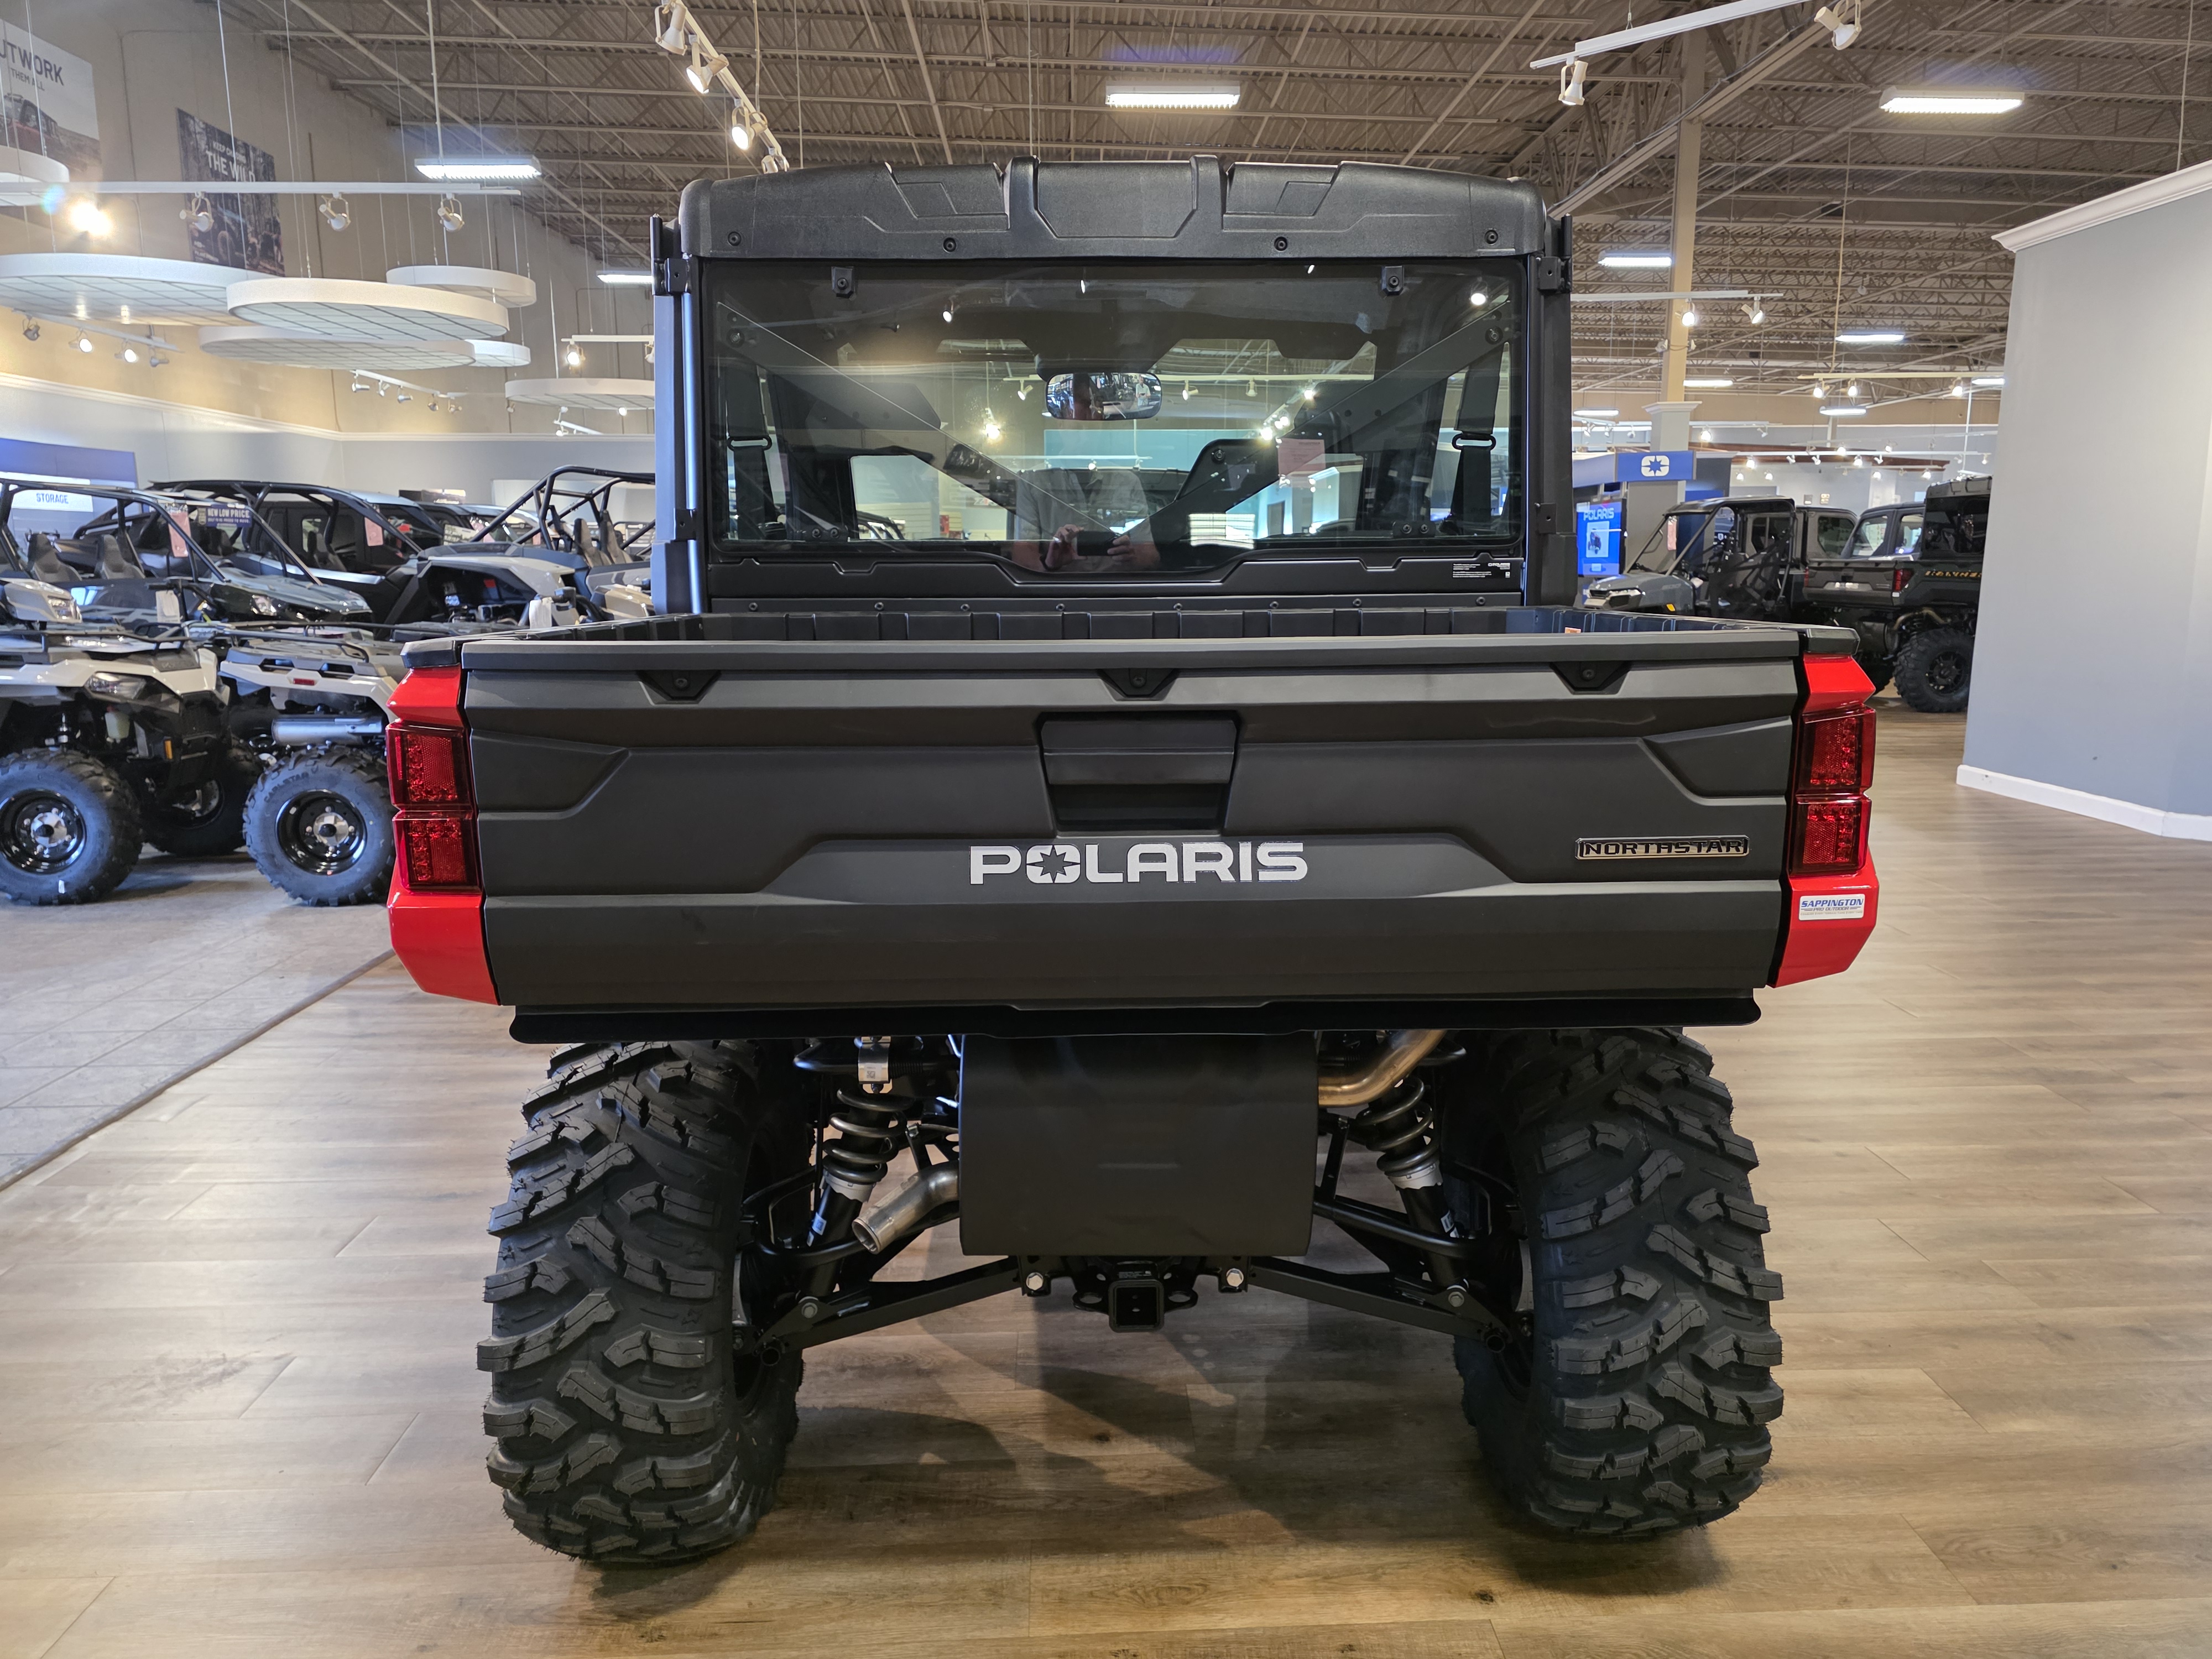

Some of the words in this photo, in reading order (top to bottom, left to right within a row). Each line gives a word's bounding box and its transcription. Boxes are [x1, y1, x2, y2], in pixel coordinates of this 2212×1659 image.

[11, 67, 30, 84] THEM
[206, 150, 228, 175] THE
[36, 493, 69, 504] STORAGE
[219, 509, 229, 517] LOW
[231, 509, 249, 518] PRICE
[1584, 508, 1614, 521] POLARIS
[1585, 839, 1743, 855] NORTHSTAR
[969, 841, 1308, 885] POLARIS
[1801, 899, 1864, 907] SAPPINGTON
